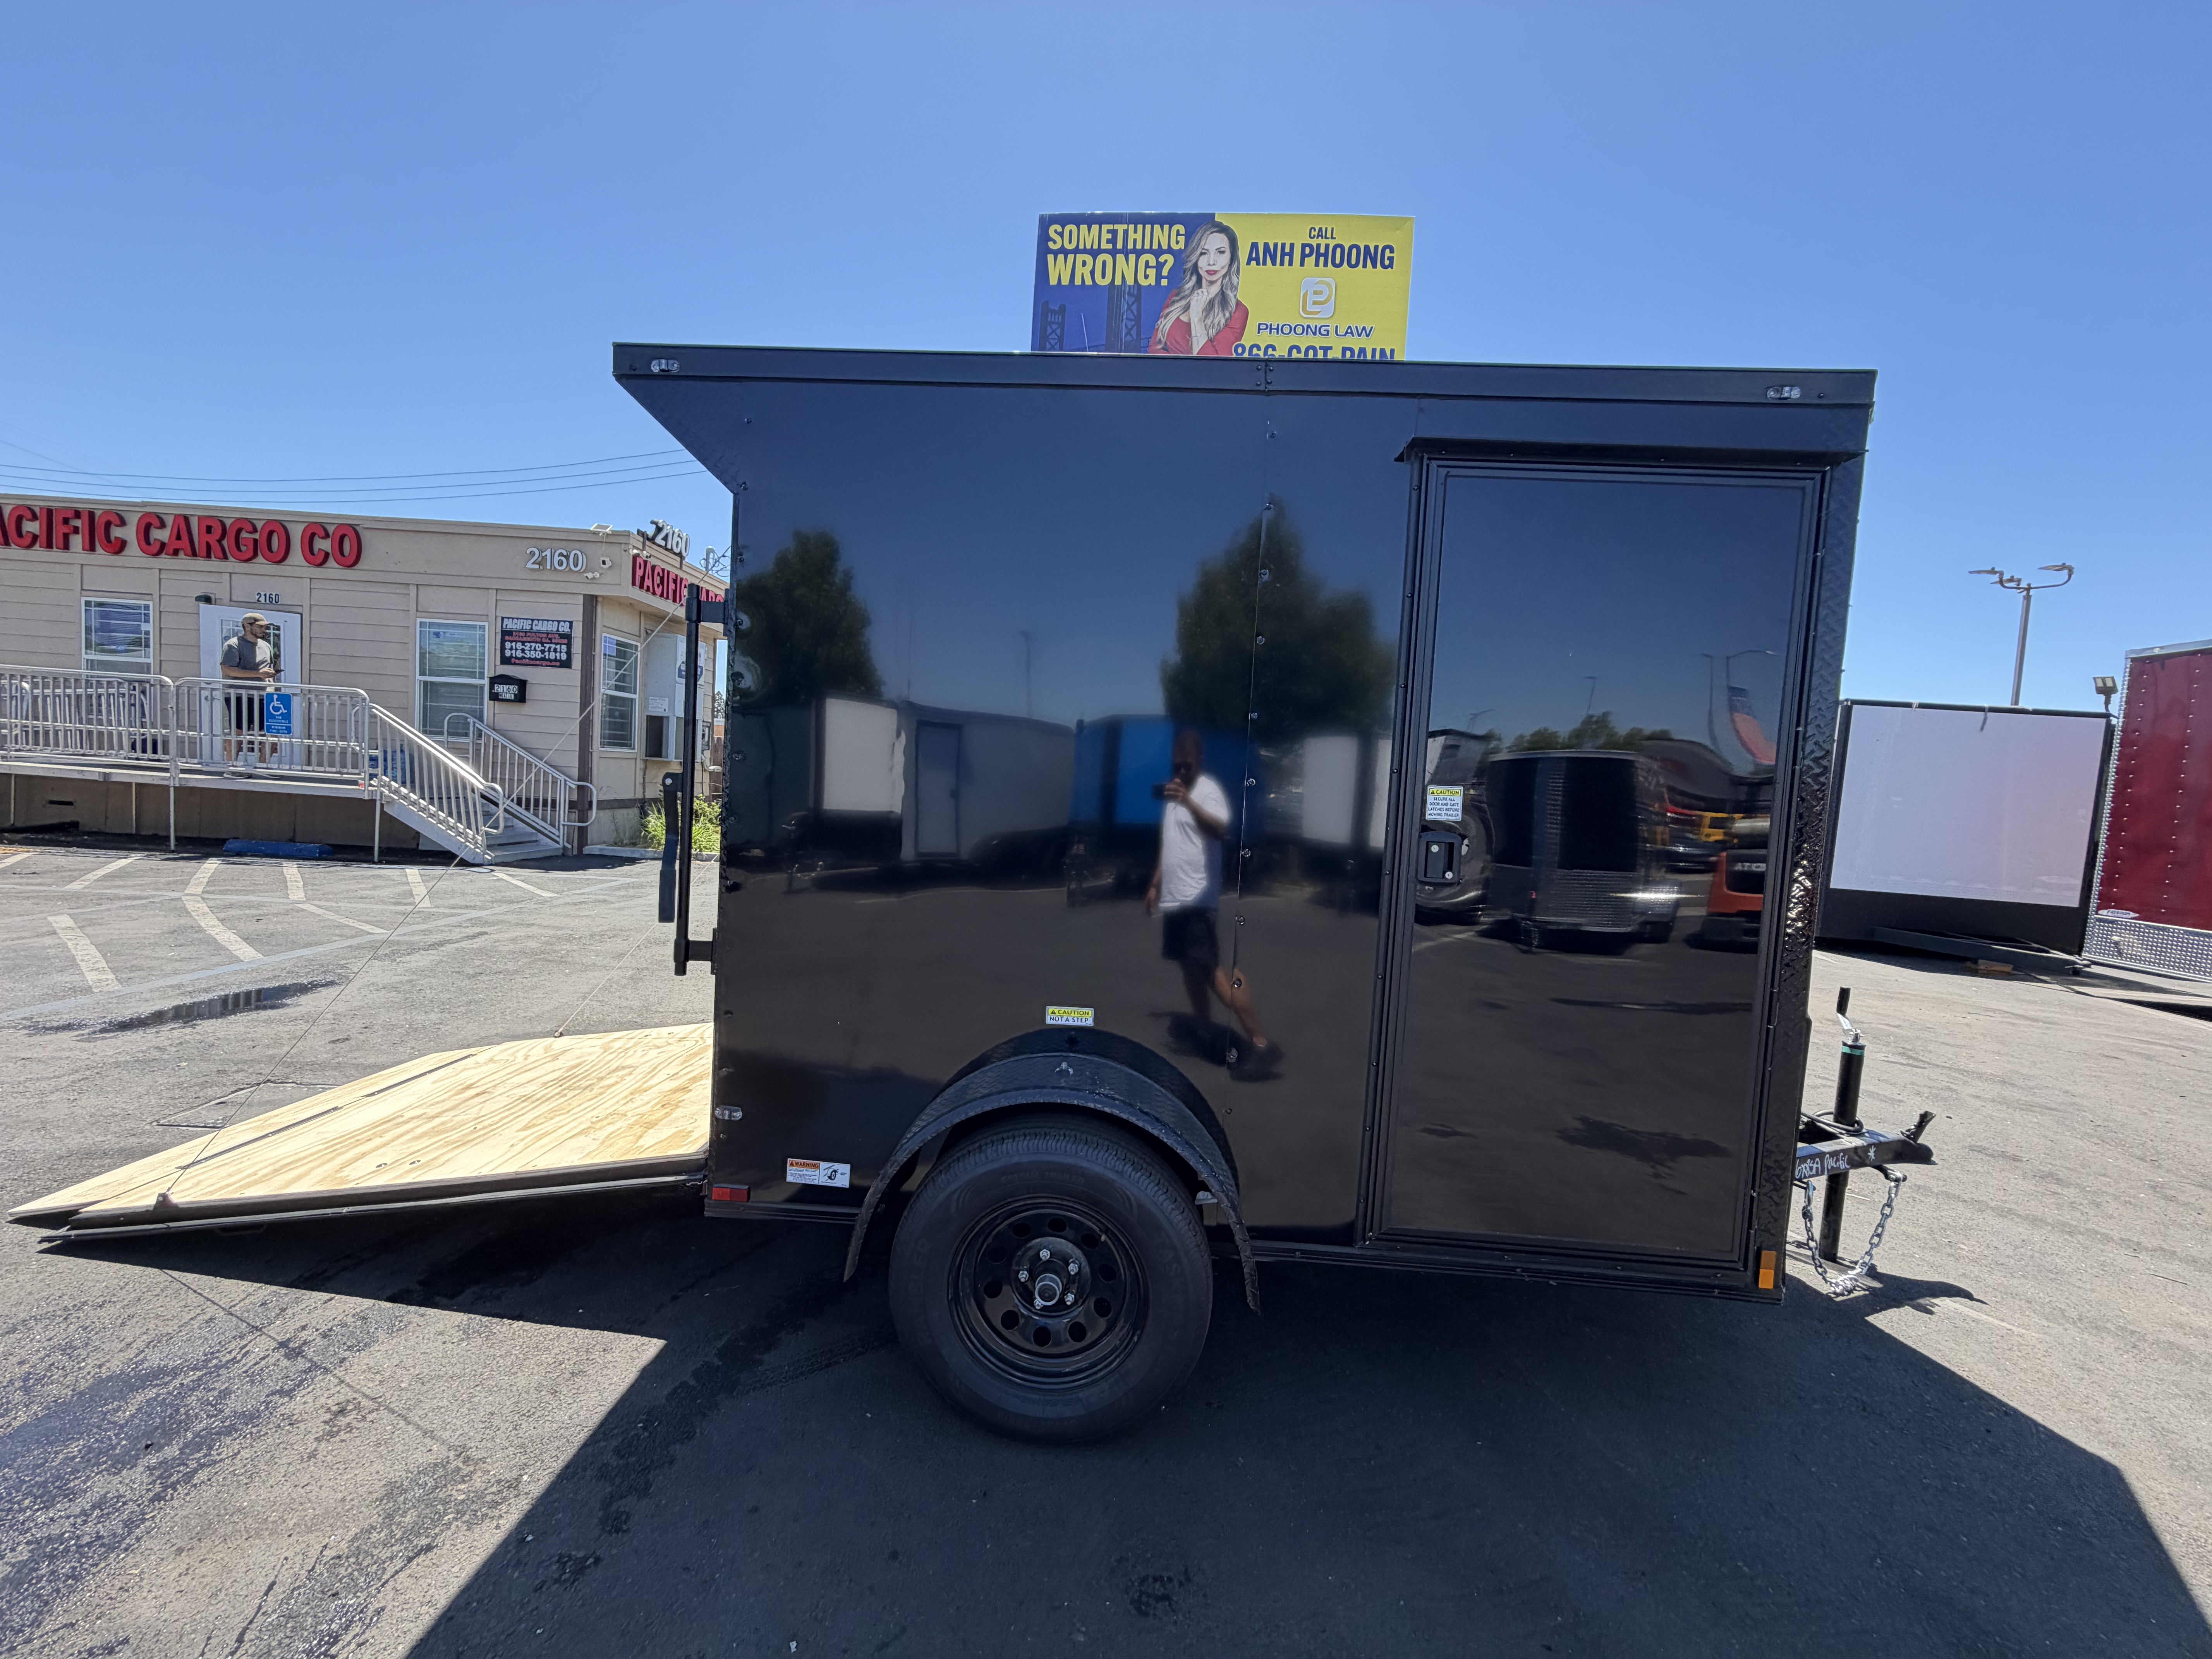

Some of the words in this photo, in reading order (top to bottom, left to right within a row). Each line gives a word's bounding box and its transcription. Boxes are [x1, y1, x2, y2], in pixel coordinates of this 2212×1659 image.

[1048, 224, 1185, 249] SOMETHING
[1309, 227, 1336, 239] CALL
[1245, 241, 1295, 267] ANH
[1299, 242, 1395, 270] PHOONG
[1047, 253, 1175, 286] WRONG?
[1257, 322, 1331, 337] PHOONG
[1334, 325, 1374, 338] LAW
[136, 512, 291, 563] CARGO
[301, 522, 362, 568] CO
[655, 519, 690, 558] 2160
[526, 547, 586, 572] 2160
[633, 555, 689, 606] PACIFIC
[256, 592, 280, 604] 2160
[503, 618, 532, 629] PACIFIC
[532, 620, 558, 631] CARGO
[558, 621, 571, 632] CO.
[505, 641, 567, 653] 916-270-7715
[505, 649, 567, 660] 916-350-1819
[1824, 1152, 1851, 1175] Pacific
